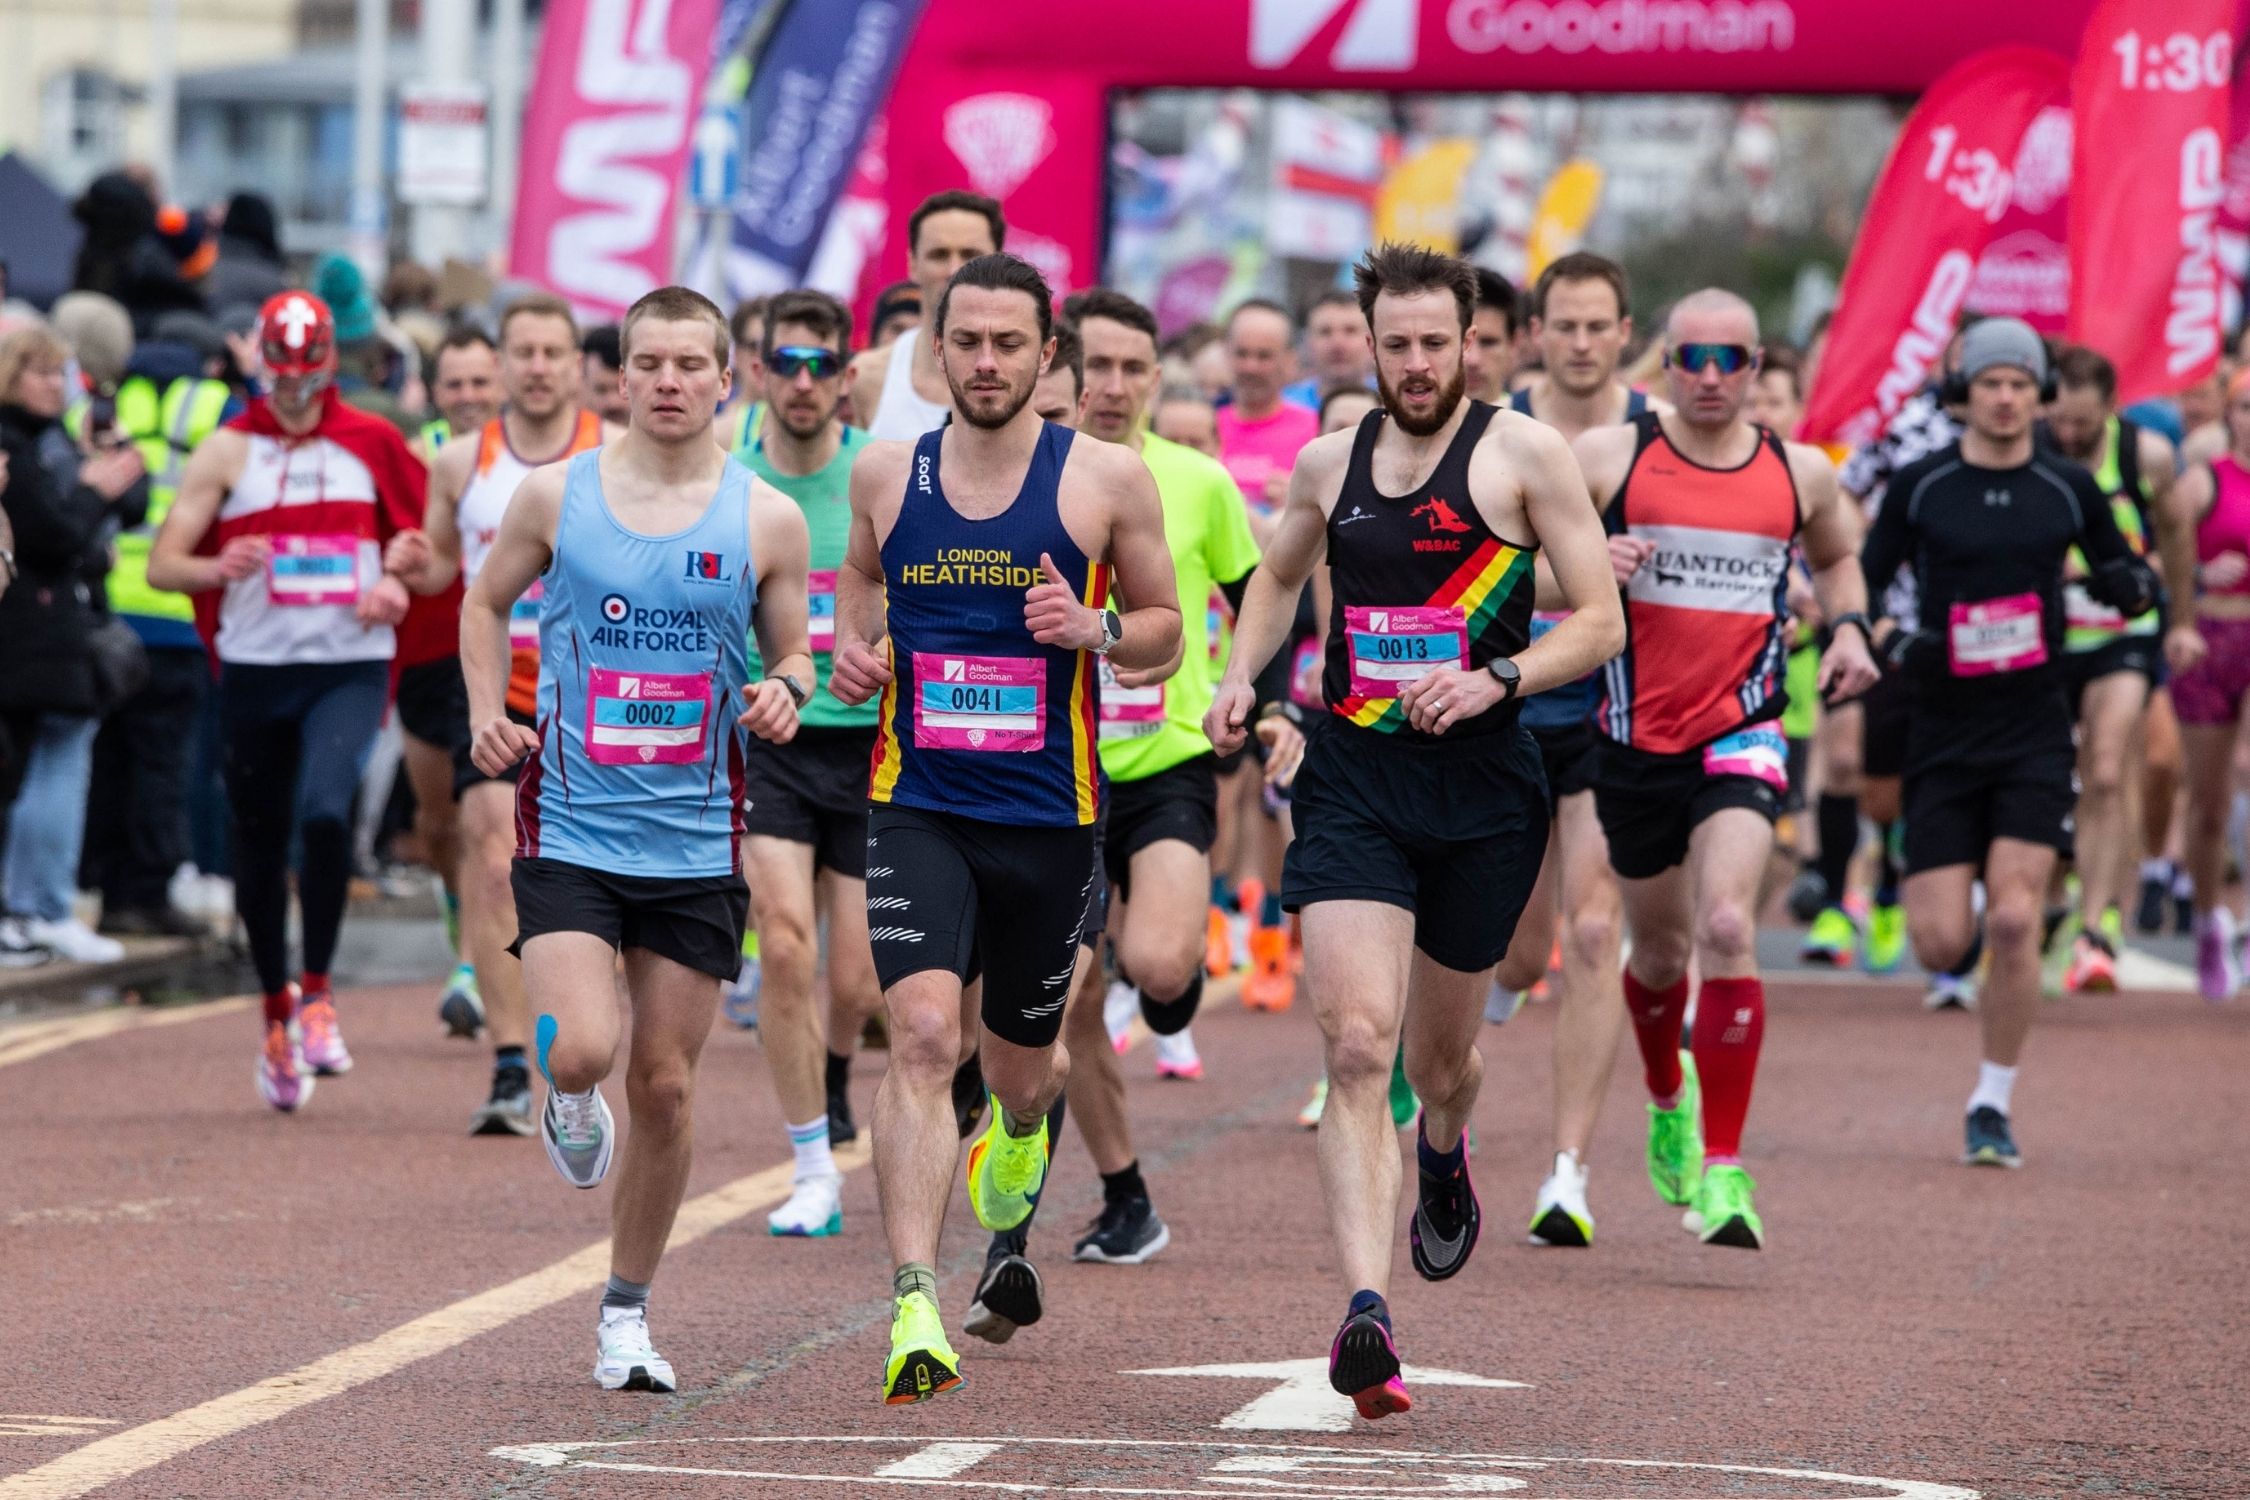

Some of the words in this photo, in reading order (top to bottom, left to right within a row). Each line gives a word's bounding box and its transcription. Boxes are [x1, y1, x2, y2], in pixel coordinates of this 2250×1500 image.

[1446, 0, 1796, 53] Goodman
[2112, 28, 2233, 91] 1:30
[918, 454, 932, 495] soar
[937, 548, 1011, 564] LONDON
[1412, 539, 1461, 552] W&BAC
[902, 564, 1050, 588] HEATHSIDE
[1643, 551, 1780, 579] UANTOCK
[634, 607, 706, 629] ROYAL
[1392, 614, 1418, 623] Albert
[1392, 622, 1434, 631] Goodman
[590, 626, 629, 649] AIR
[633, 630, 707, 652] FORCE
[1378, 638, 1428, 660] 0013
[968, 672, 1012, 682] Goodman
[969, 664, 997, 673] Albert
[643, 681, 671, 690] Albert
[643, 689, 685, 698] Goodman
[951, 687, 1001, 712] 0041
[626, 703, 676, 726] 0002
